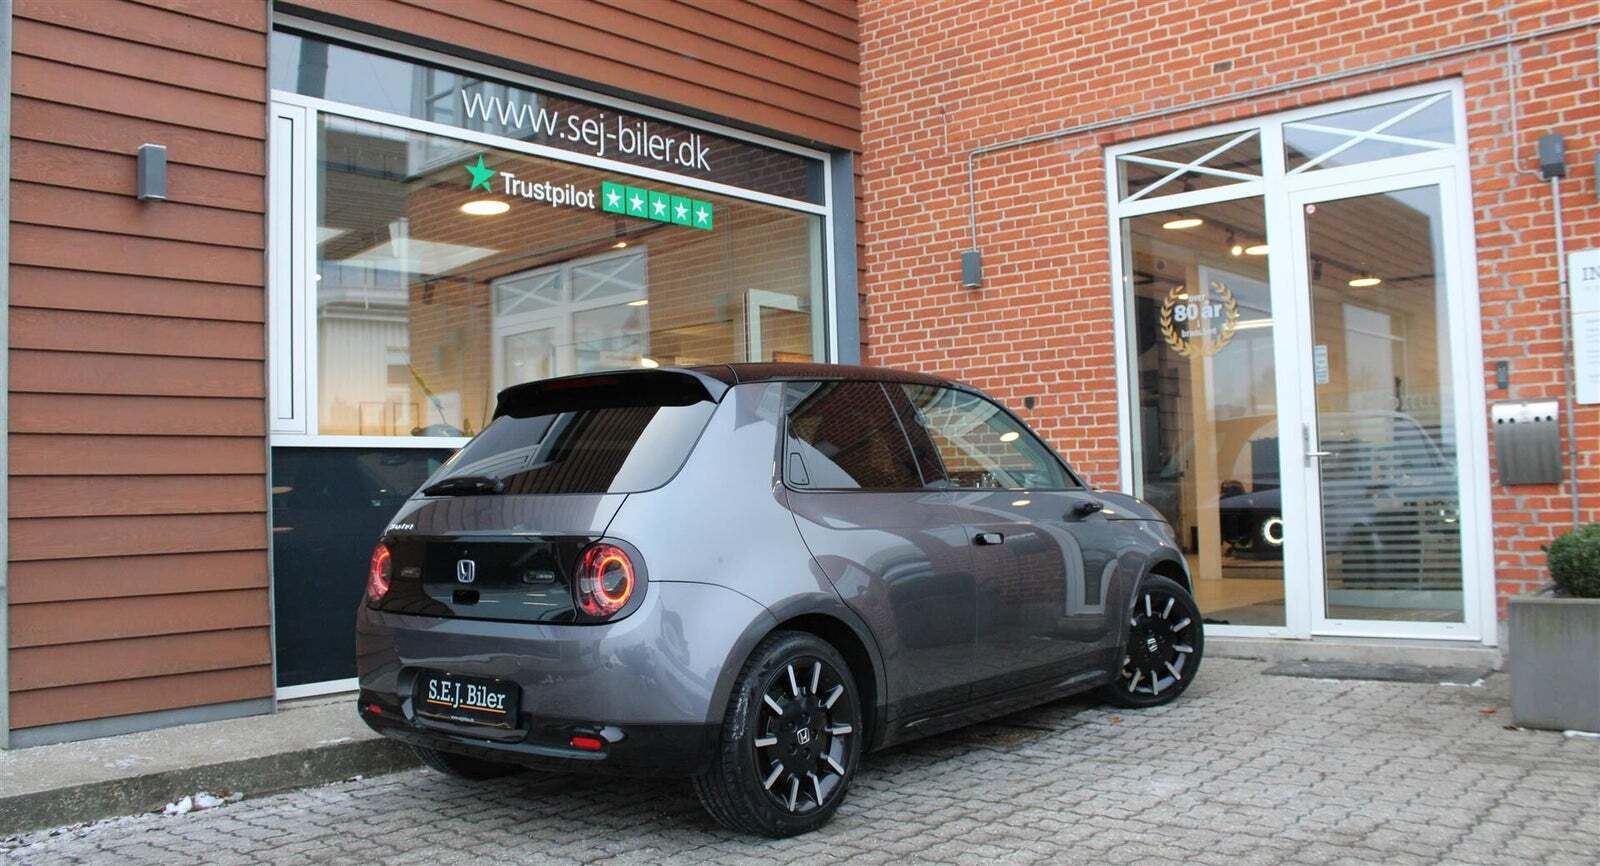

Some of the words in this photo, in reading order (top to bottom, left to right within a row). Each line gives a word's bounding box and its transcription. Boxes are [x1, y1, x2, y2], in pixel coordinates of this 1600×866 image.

[461, 89, 712, 172] www.sej-biler.dk
[500, 171, 596, 209] Trustpilot
[1174, 303, 1198, 322] 80
[1201, 300, 1223, 319] år
[428, 679, 463, 708] S.E.J.
[466, 684, 506, 709] Biler
